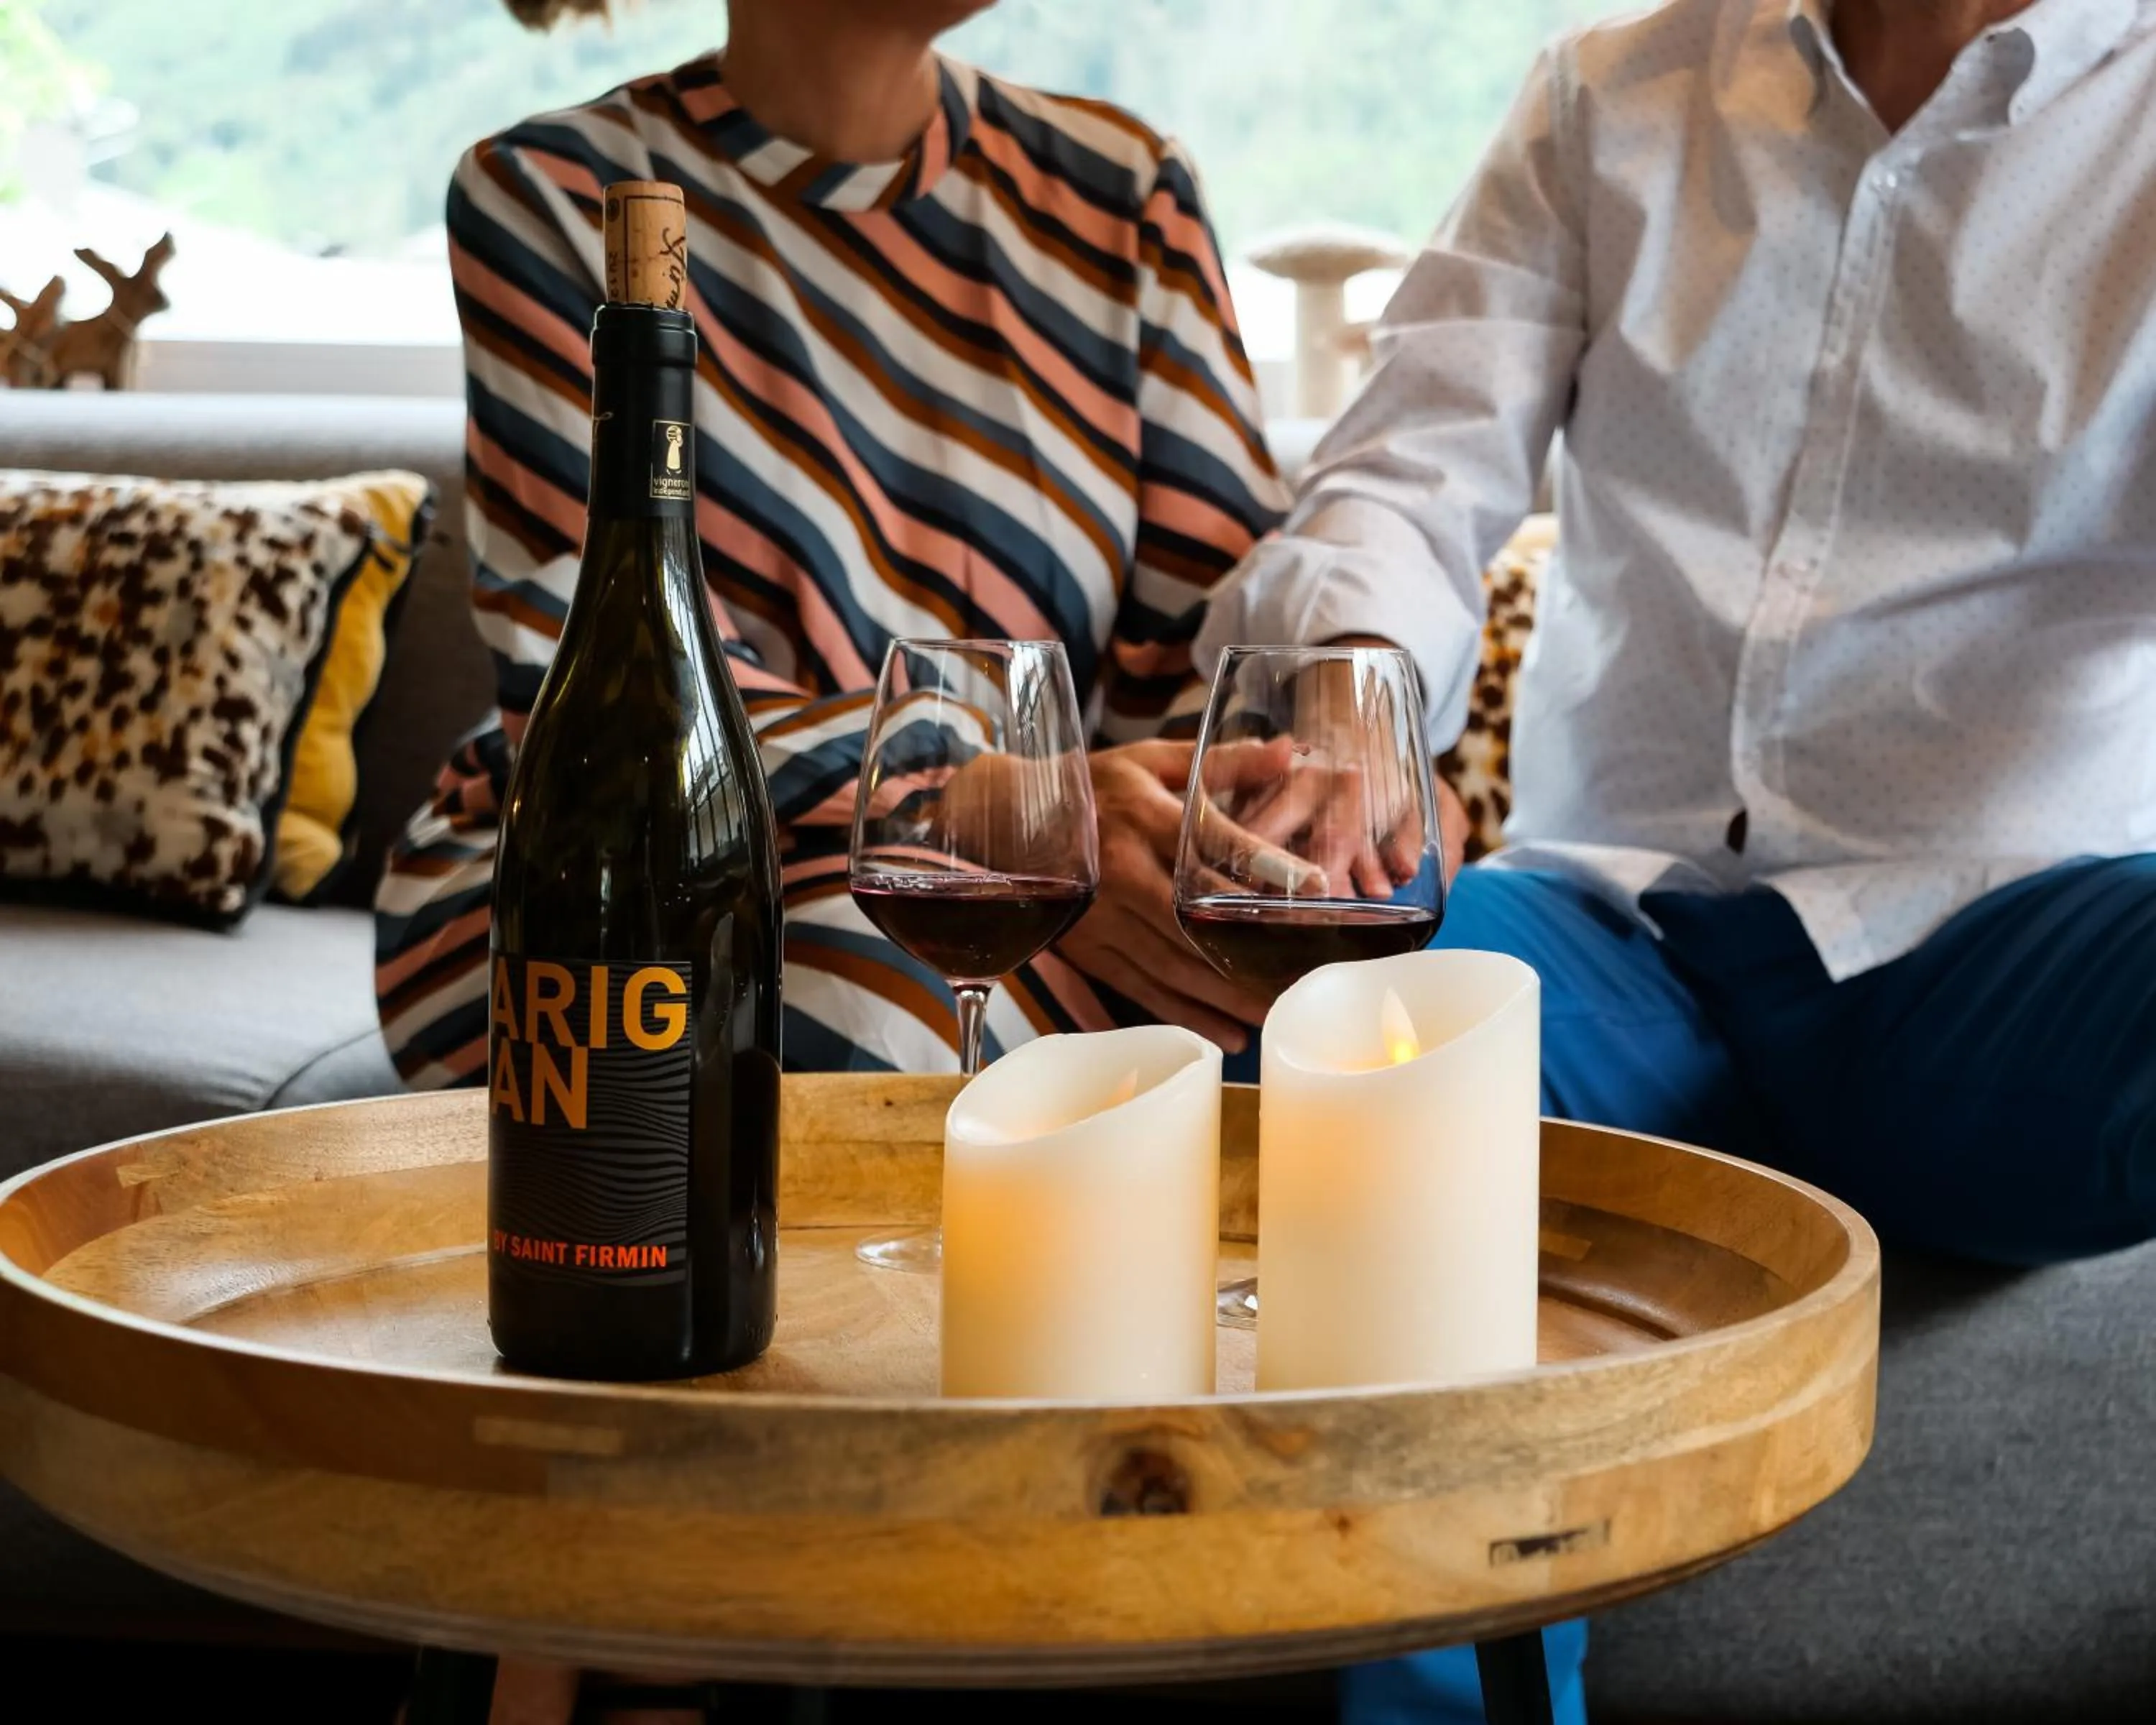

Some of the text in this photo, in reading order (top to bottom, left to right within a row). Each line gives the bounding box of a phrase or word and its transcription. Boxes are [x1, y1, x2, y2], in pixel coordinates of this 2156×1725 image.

[490, 956, 688, 1051] ARIG
[492, 1036, 589, 1130] AN
[510, 1236, 568, 1265] SAINT
[575, 1243, 668, 1268] FIRMIN
